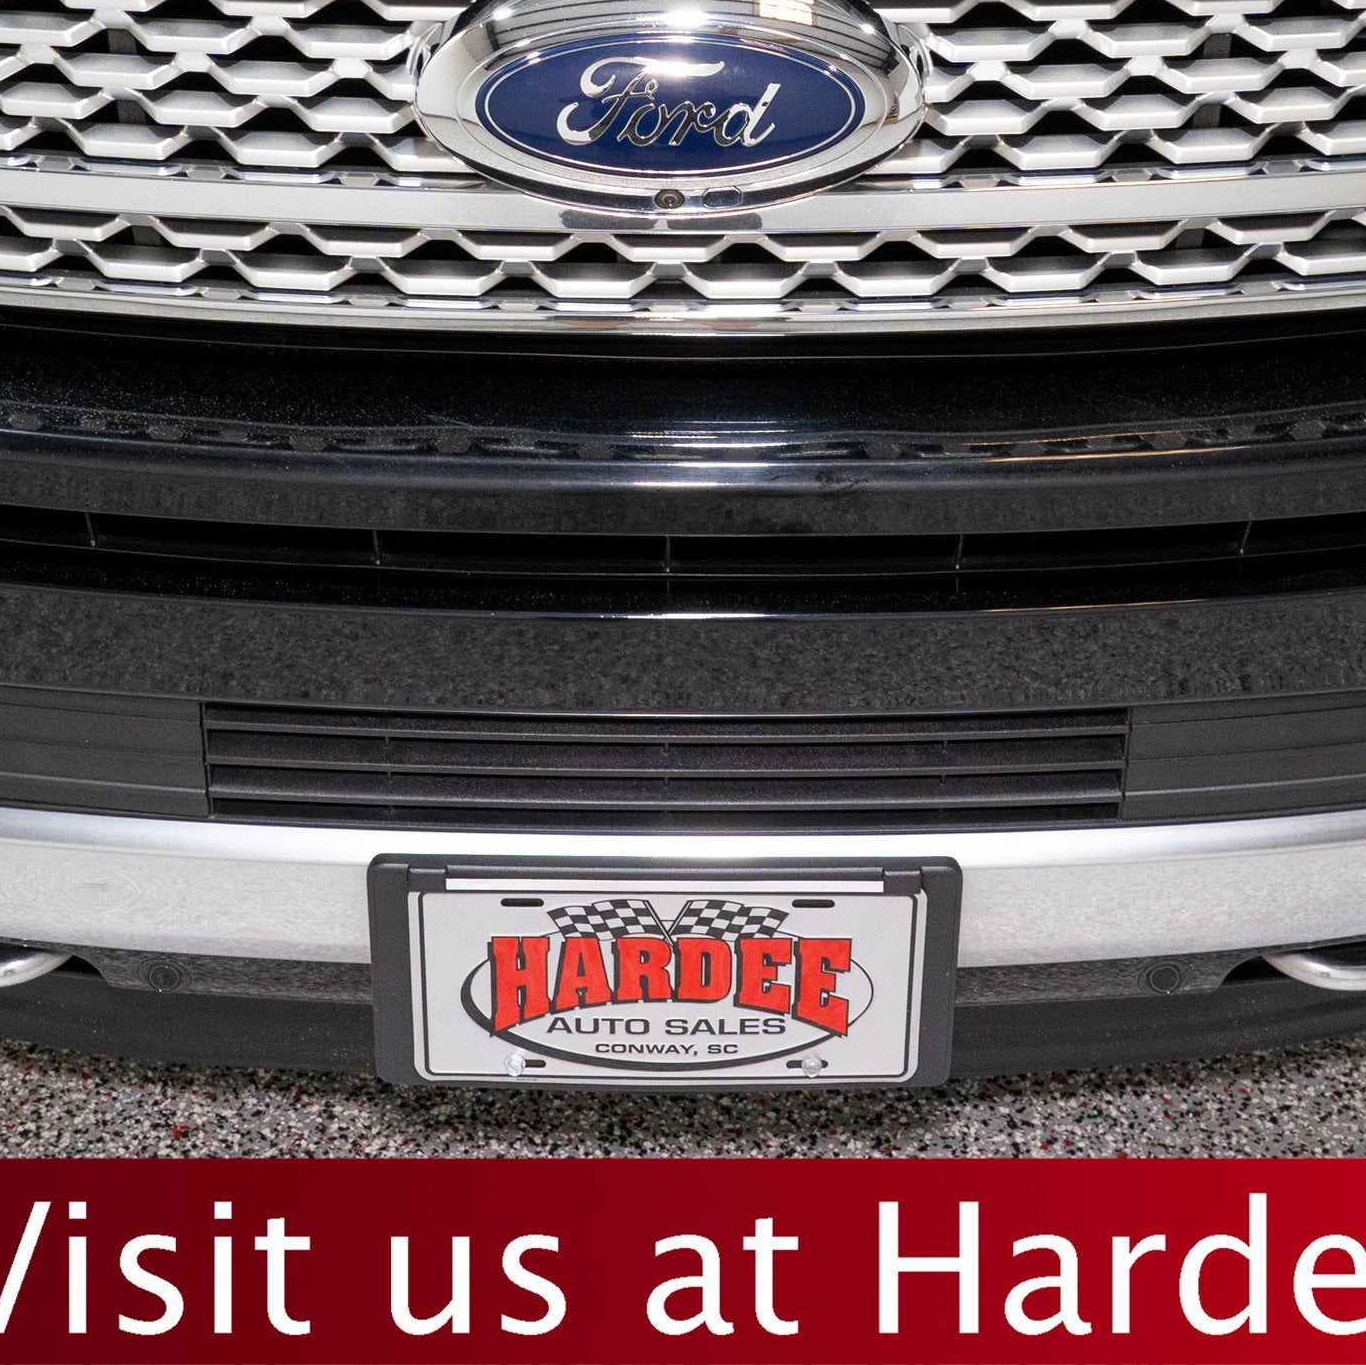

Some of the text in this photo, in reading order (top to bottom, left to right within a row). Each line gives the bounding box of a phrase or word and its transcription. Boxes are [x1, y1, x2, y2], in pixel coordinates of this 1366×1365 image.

[557, 56, 782, 148] Ford
[488, 936, 852, 1037] HARDEE
[546, 1016, 786, 1036] AUTO SALES
[594, 1043, 738, 1057] CONWAY, SC
